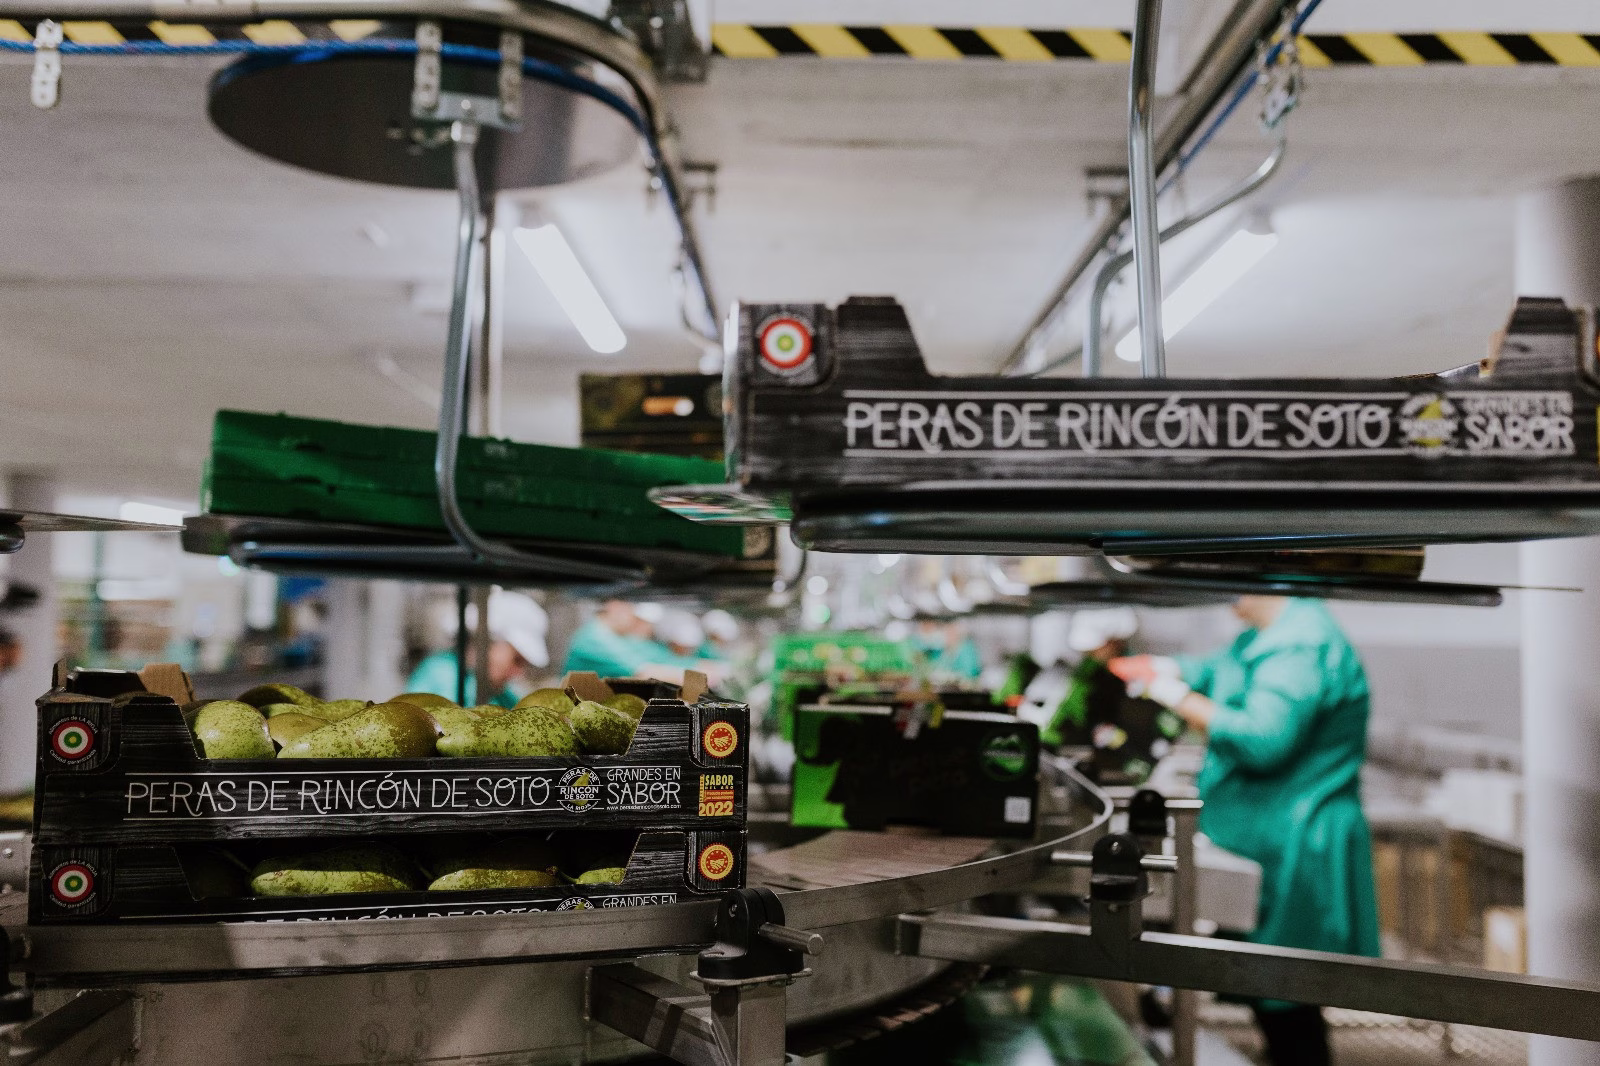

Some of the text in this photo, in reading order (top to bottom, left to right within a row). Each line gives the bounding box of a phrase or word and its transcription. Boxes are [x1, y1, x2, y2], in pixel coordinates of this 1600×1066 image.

[843, 402, 984, 454] PERAS
[992, 402, 1049, 448] DE
[1056, 393, 1218, 454] RINCÓN
[1227, 402, 1282, 448] DE
[1285, 402, 1393, 448] SOTO
[1464, 414, 1575, 452] SABOR
[561, 768, 599, 784] PERAS DE
[606, 767, 681, 783] GRANDES EN
[705, 774, 734, 786] SABOR
[124, 772, 553, 817] PERAS DE RINCÓN DE SOTO
[606, 781, 681, 805] SABOR
[698, 800, 734, 817] 2022
[602, 895, 658, 909] GRANDES
